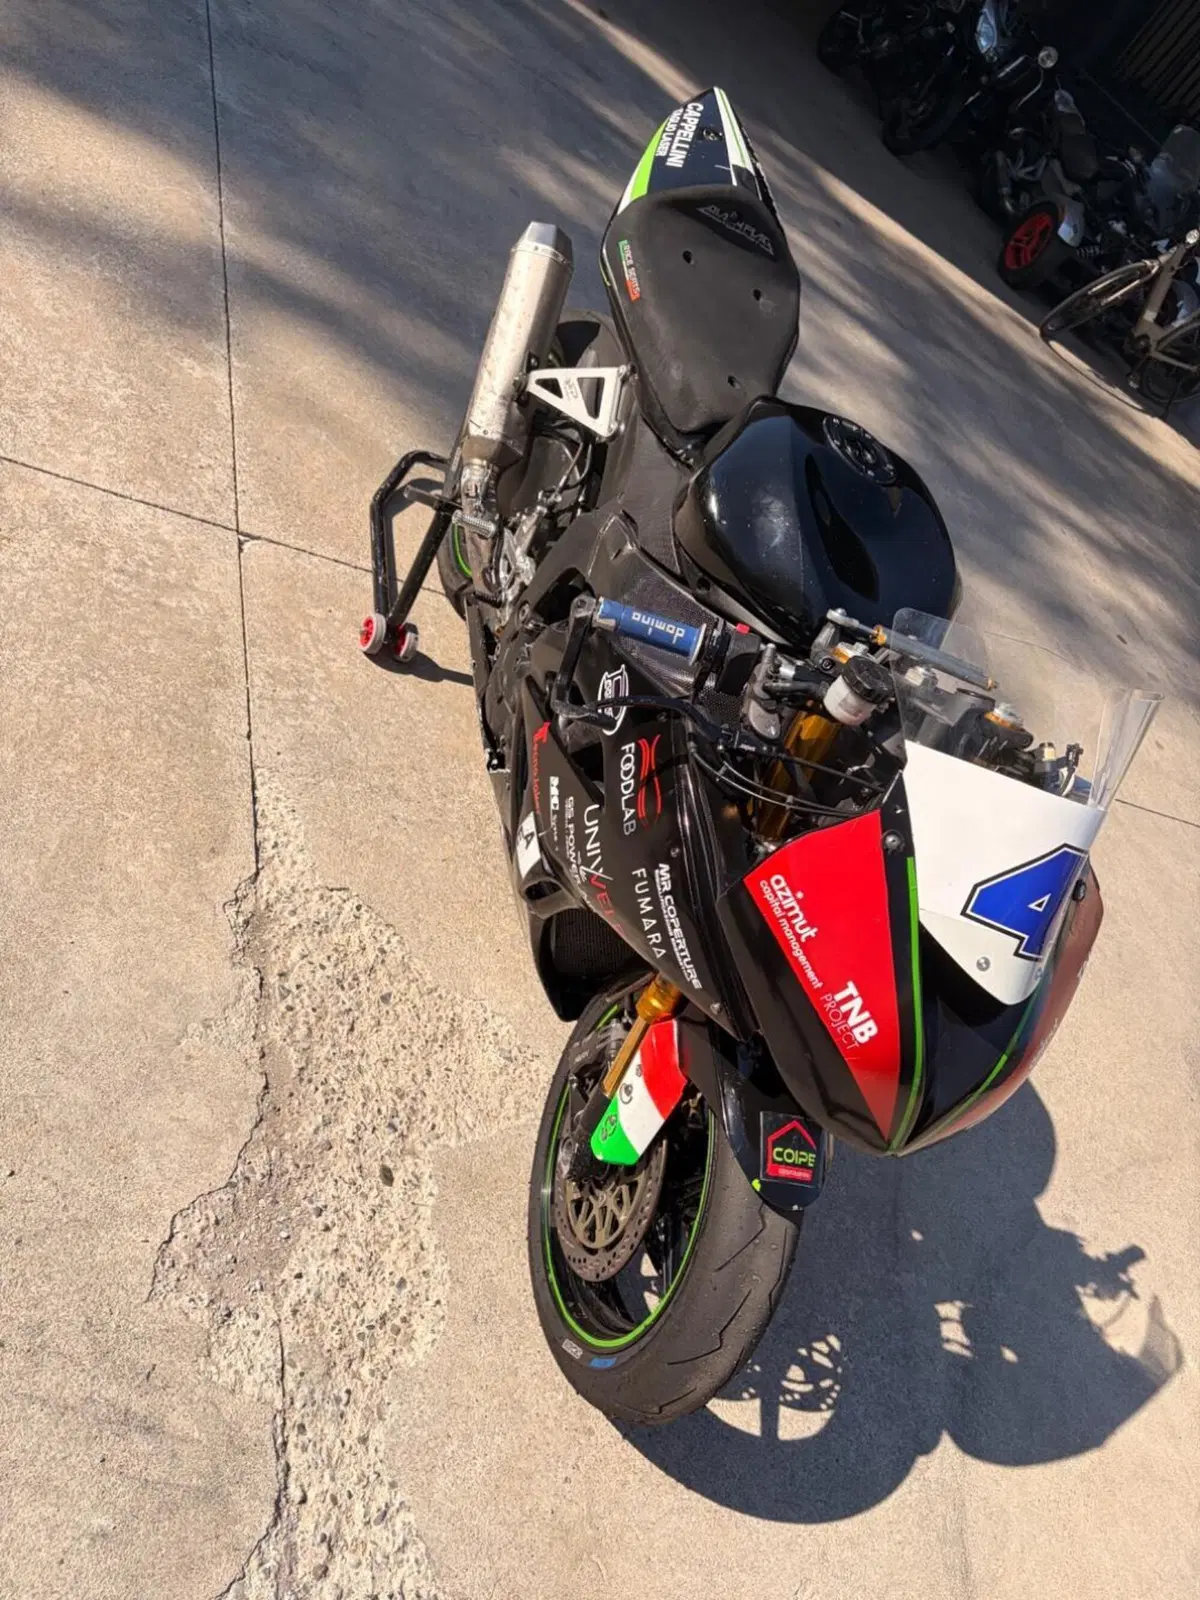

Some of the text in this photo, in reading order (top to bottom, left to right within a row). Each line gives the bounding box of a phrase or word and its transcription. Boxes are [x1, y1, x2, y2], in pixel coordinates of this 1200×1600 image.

[655, 130, 675, 157] LASER
[665, 102, 704, 168] CAPPELLINI
[632, 611, 686, 644] domino
[620, 742, 637, 836] FOODLAB
[632, 868, 667, 959] FUMARA
[658, 863, 703, 989] MR COPERTURE
[760, 879, 824, 990] capital management
[770, 874, 818, 943] azimut
[819, 993, 860, 1050] PROJECT
[834, 980, 879, 1044] TNB
[773, 1147, 816, 1167] COIPE
